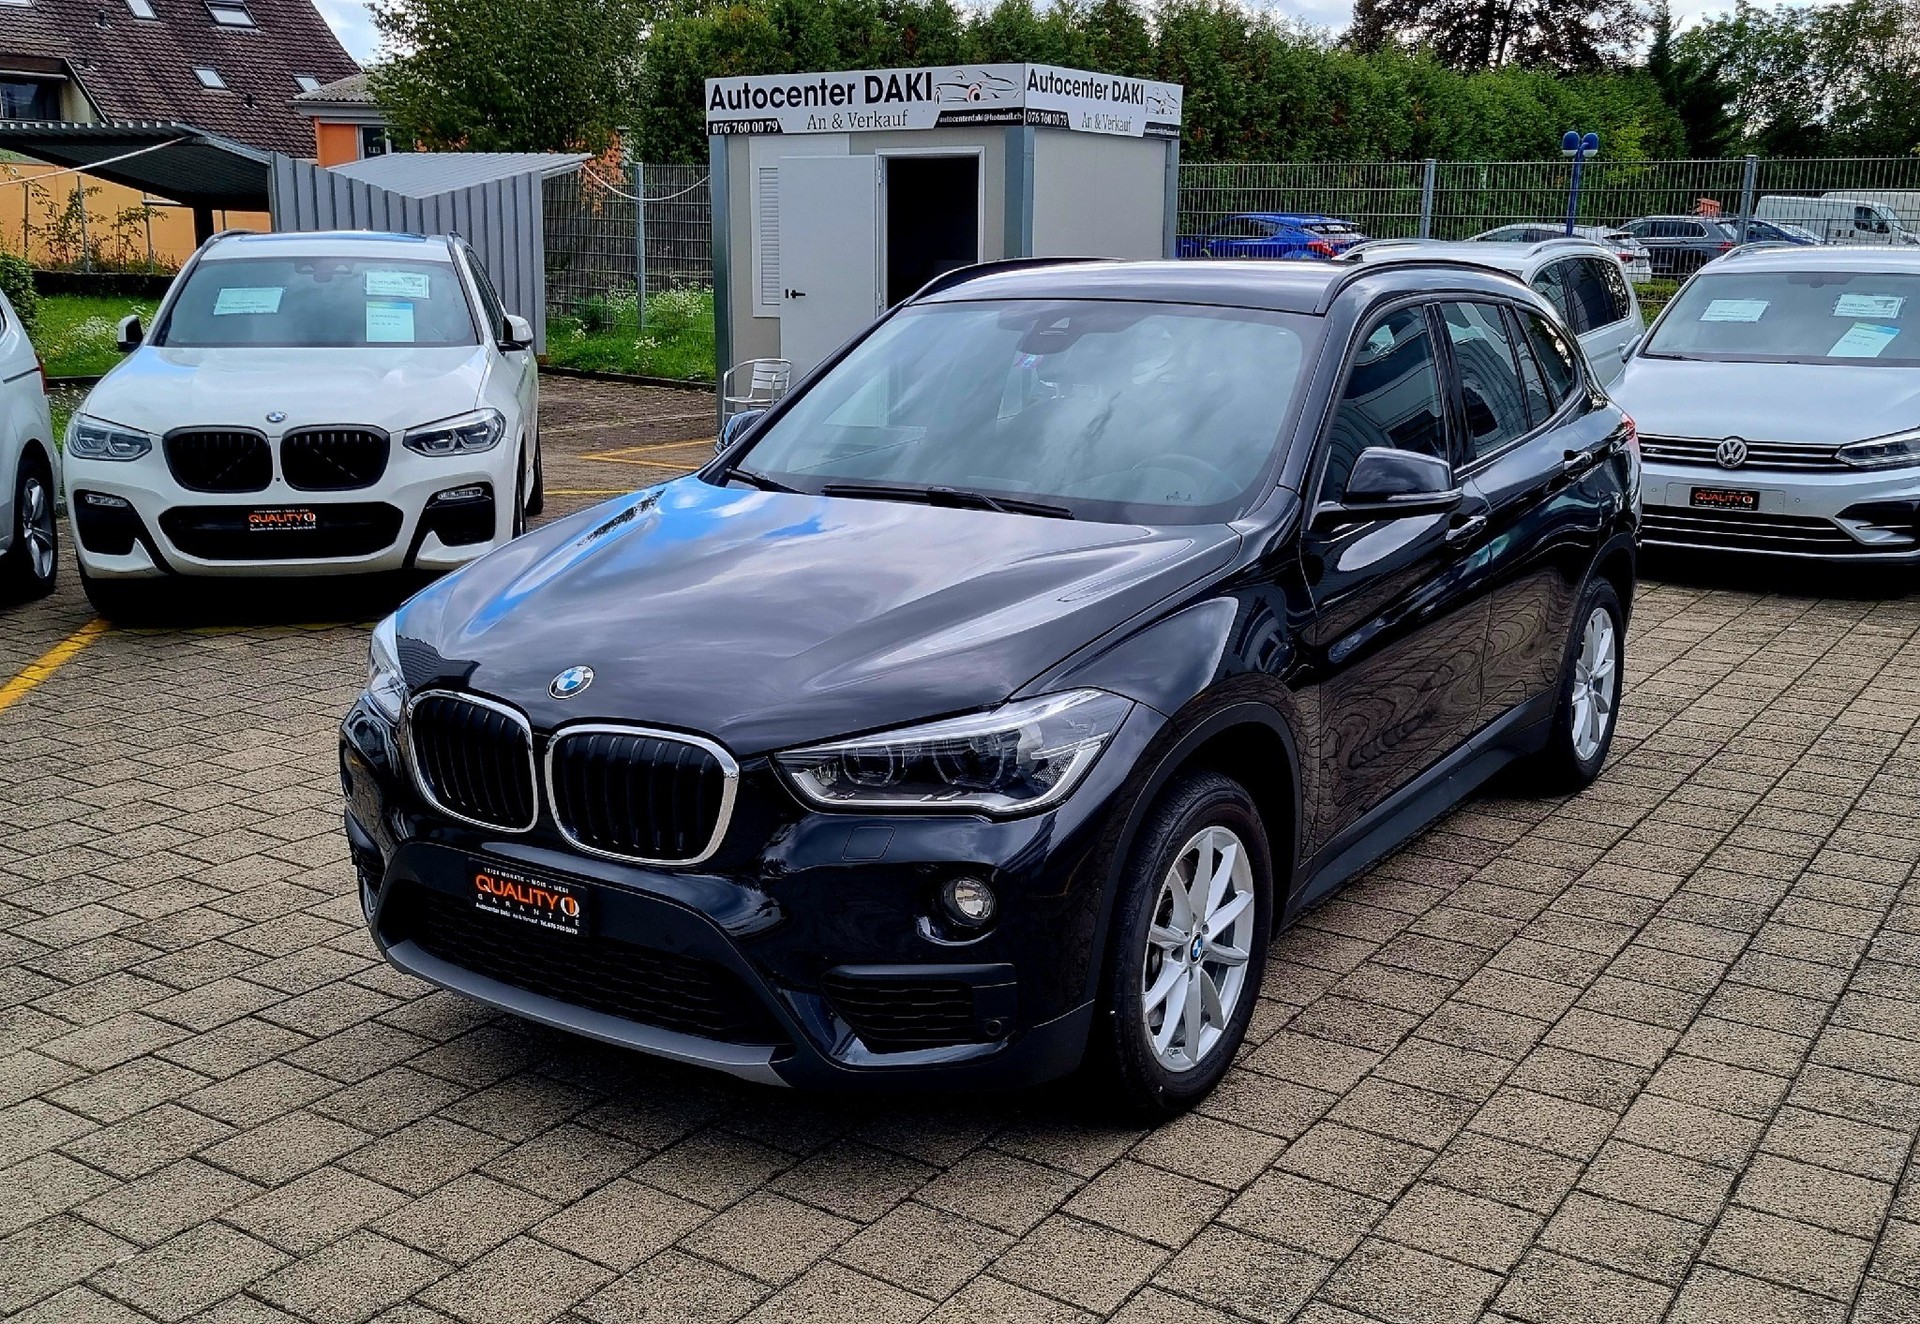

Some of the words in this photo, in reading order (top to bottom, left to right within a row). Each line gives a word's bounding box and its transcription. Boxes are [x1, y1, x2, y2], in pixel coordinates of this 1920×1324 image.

[709, 78, 856, 110] Autocenter
[864, 72, 932, 104] DAKI
[1027, 68, 1109, 100] Autocenter
[1112, 80, 1144, 105] DAKI
[712, 123, 730, 134] 076
[732, 122, 750, 133] 760
[752, 121, 763, 132] 00
[766, 120, 778, 132] 79
[807, 114, 827, 130] An
[831, 112, 843, 129] &
[847, 110, 908, 128] Verkauf
[1027, 111, 1040, 123] 076
[1081, 112, 1092, 128] An
[1094, 113, 1101, 130] &
[1102, 115, 1132, 132] Verkauf
[1695, 492, 1742, 502] QUALITY
[248, 513, 303, 523] QUALITY
[475, 874, 559, 910] QUALITY
[477, 893, 580, 927] GARANTIE
